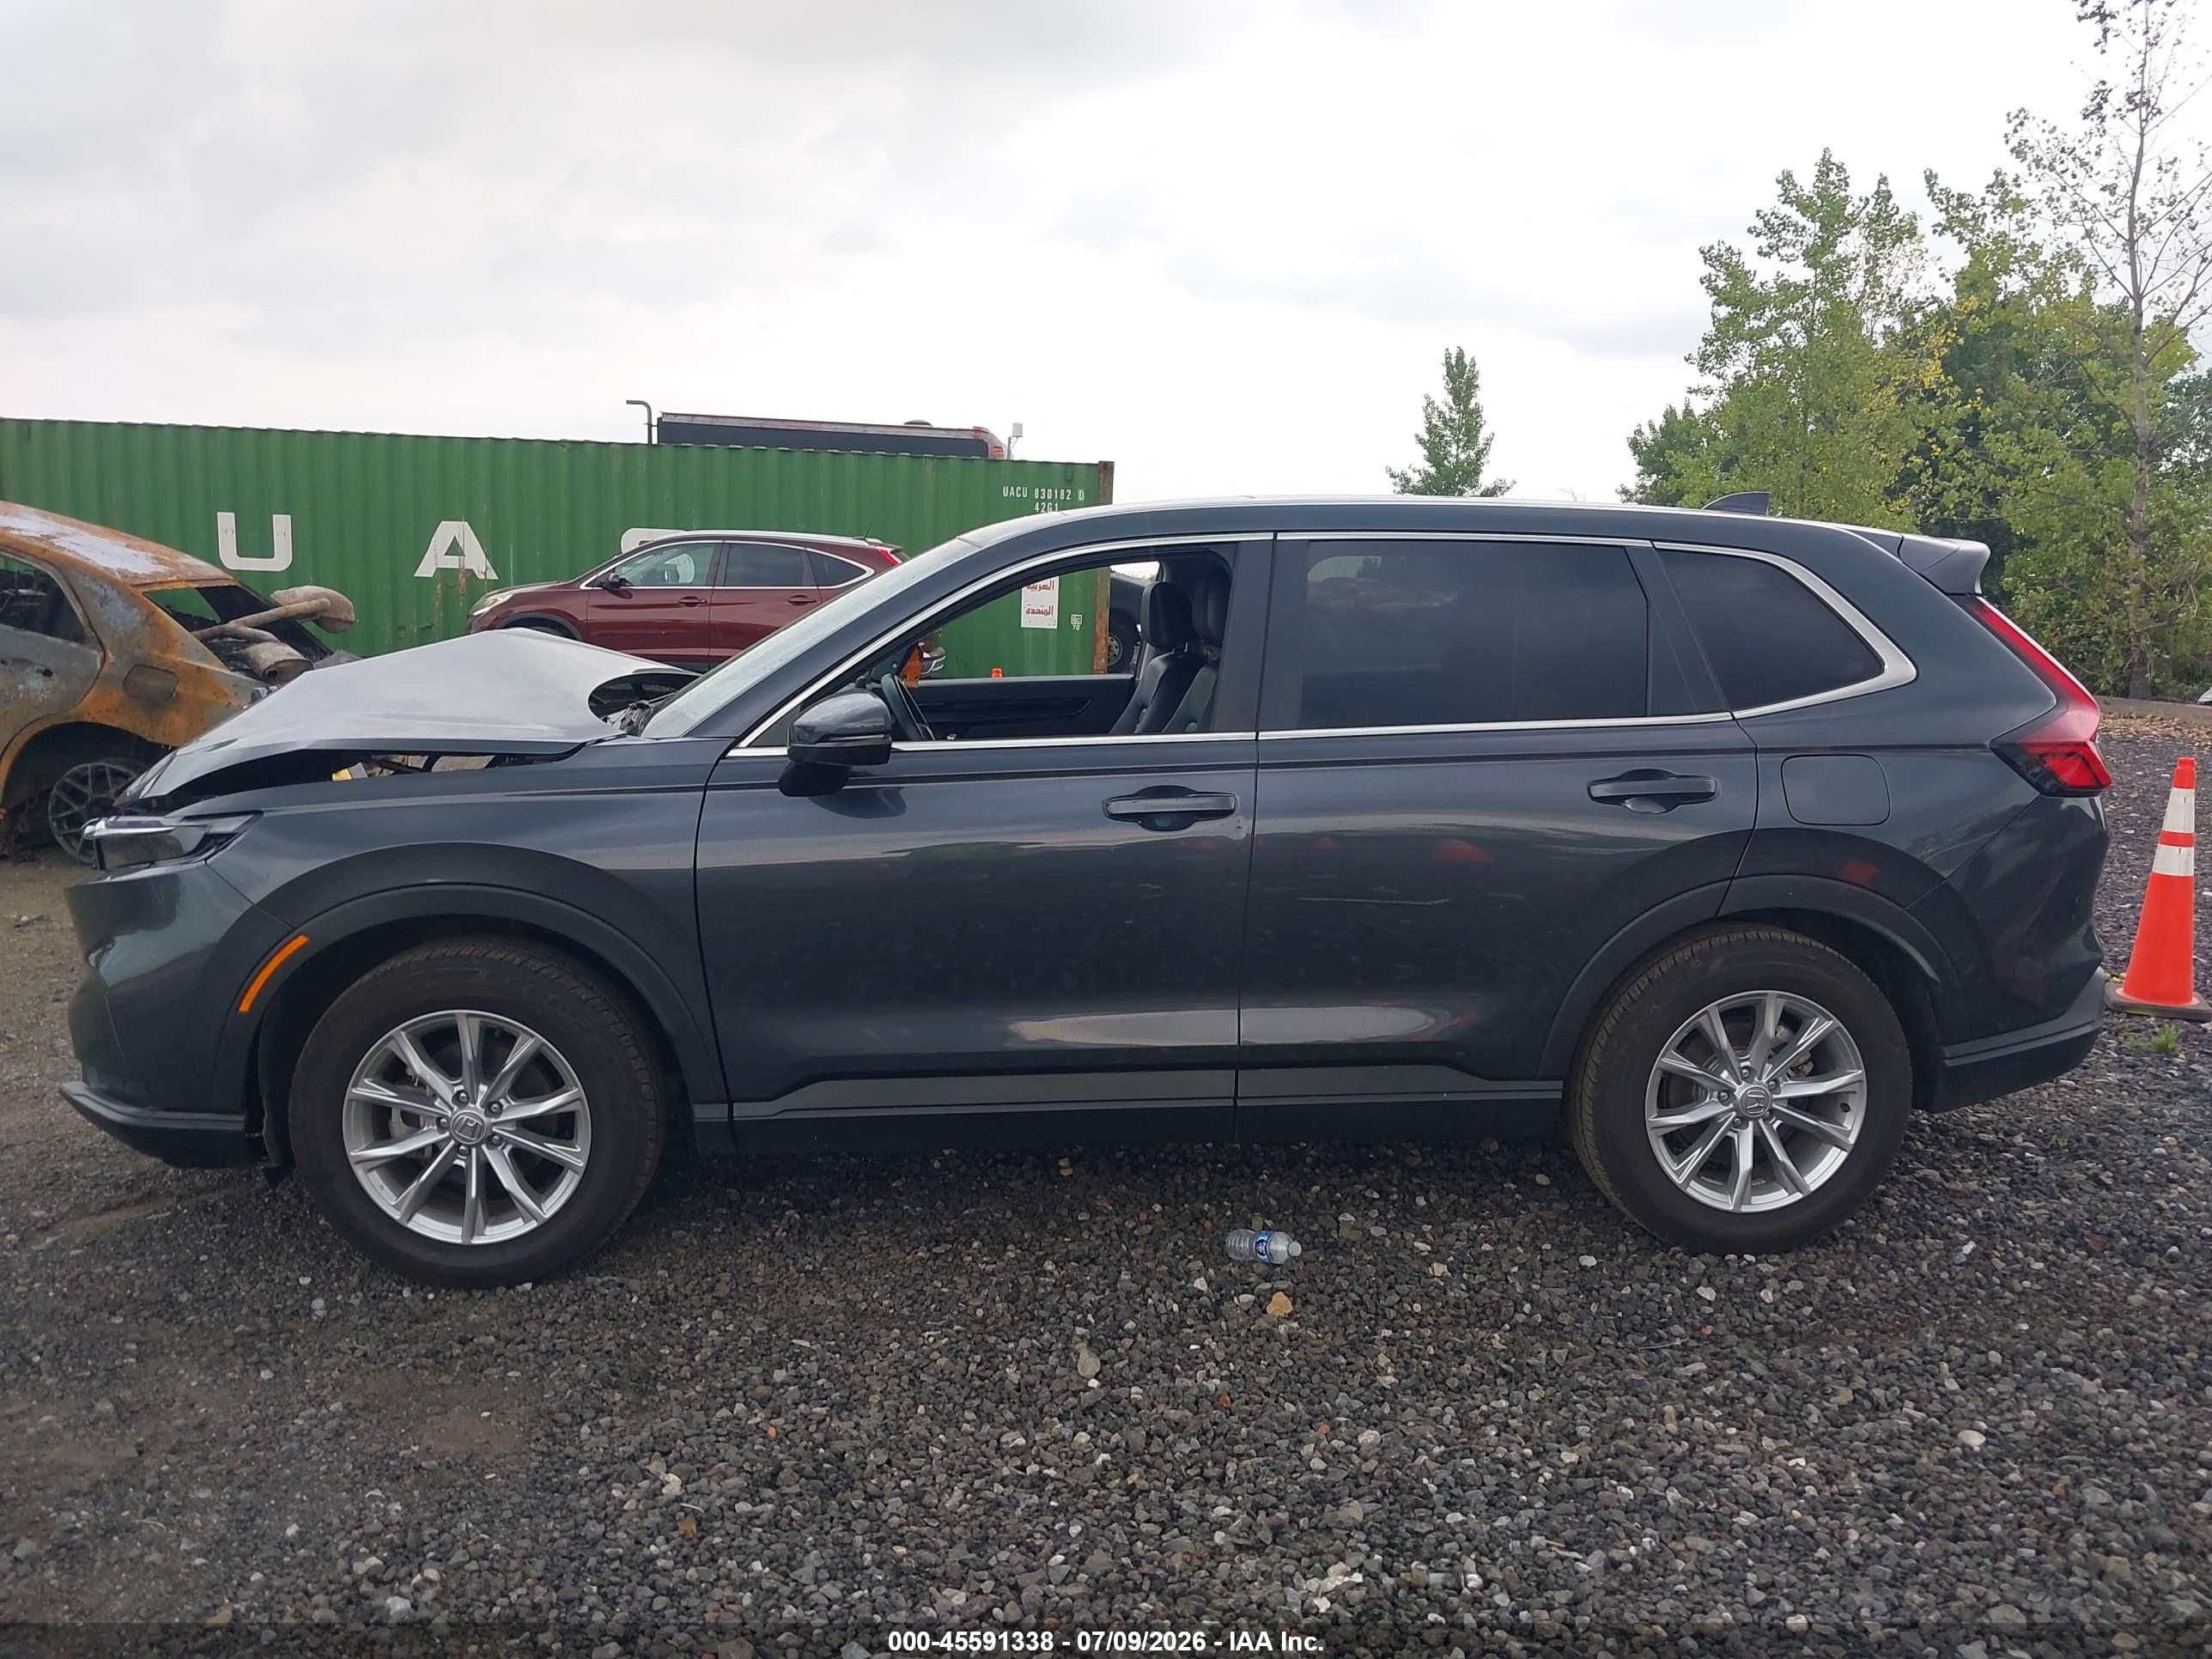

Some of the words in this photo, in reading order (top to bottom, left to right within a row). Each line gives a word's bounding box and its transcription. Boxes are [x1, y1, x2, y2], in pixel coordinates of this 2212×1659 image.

[1002, 485, 1028, 498] UACU
[1034, 488, 1072, 501] 830182
[1034, 501, 1059, 514] 42G1
